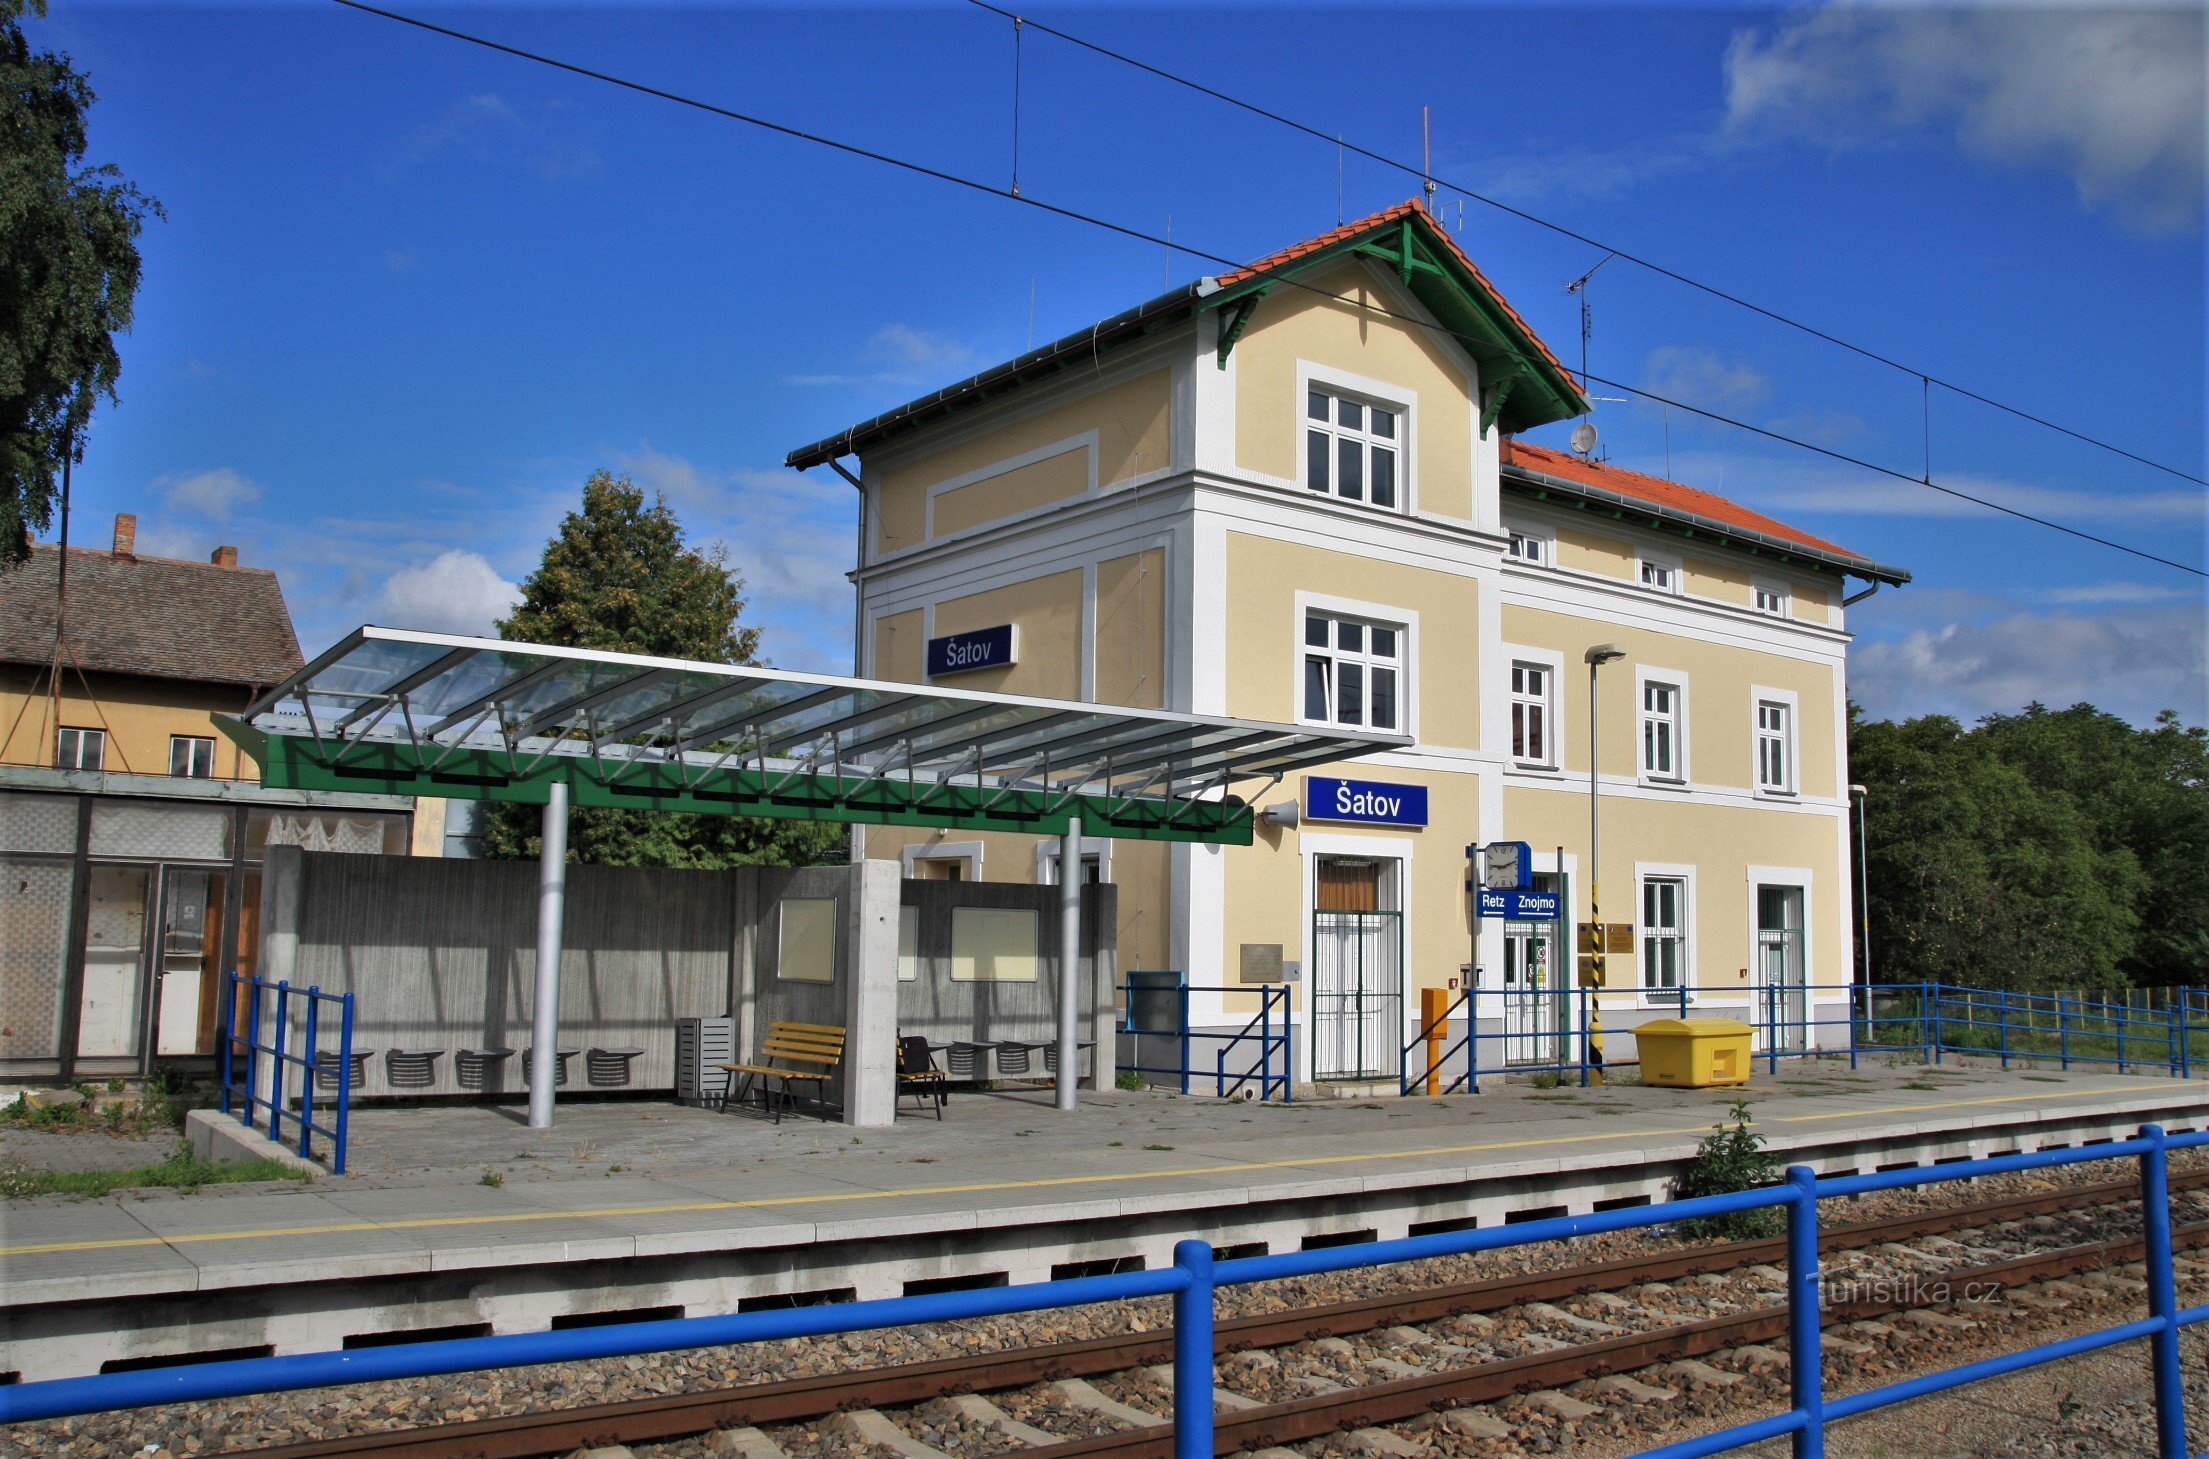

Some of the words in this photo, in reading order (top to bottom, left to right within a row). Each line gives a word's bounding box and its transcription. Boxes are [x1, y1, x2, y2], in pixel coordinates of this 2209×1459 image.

[946, 637, 992, 667] Šatov
[1336, 780, 1401, 817] Šatov
[1482, 894, 1505, 908] Retz
[1518, 895, 1555, 911] Znojmo
